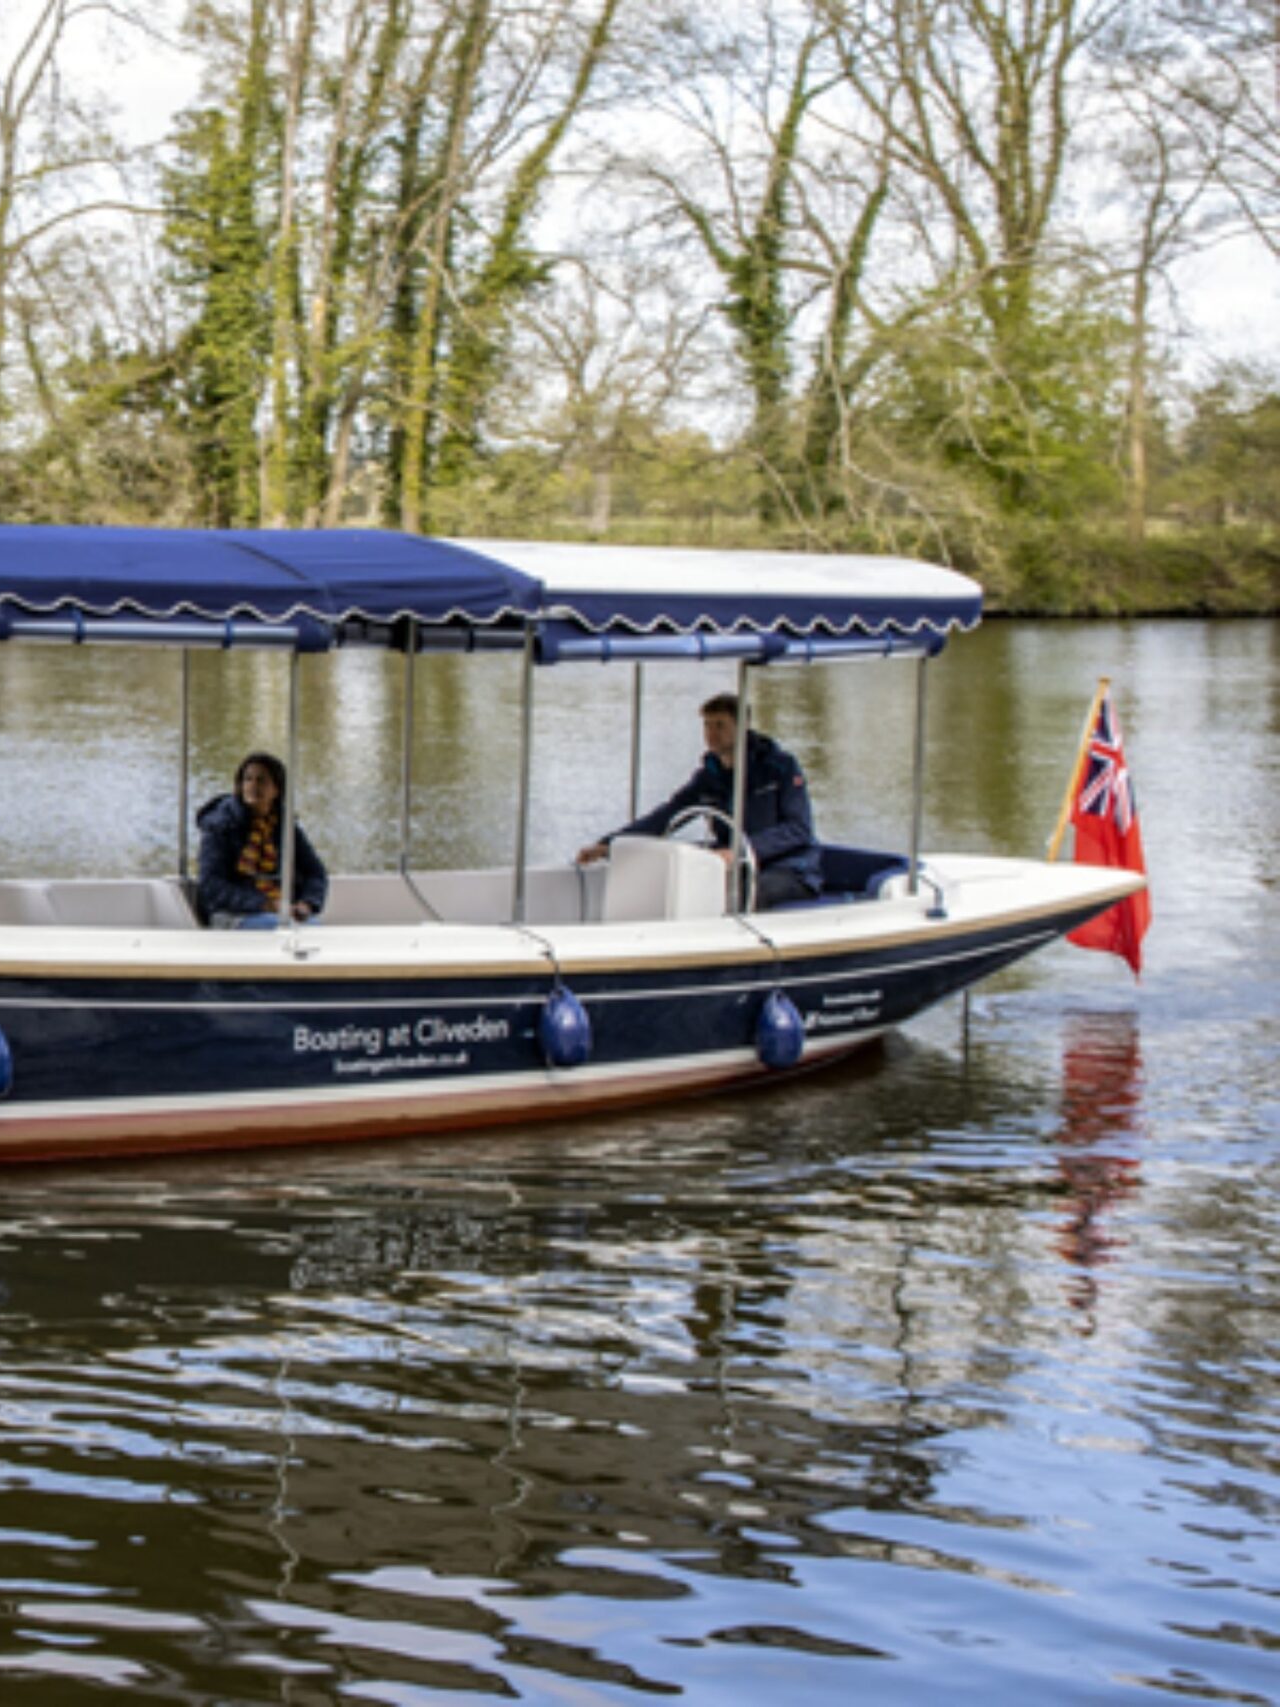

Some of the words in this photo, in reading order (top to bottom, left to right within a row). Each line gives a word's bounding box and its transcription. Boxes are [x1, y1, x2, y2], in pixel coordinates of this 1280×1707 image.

[293, 1025, 382, 1055] Boating
[387, 1024, 411, 1046] at
[415, 1014, 510, 1045] Cliveden
